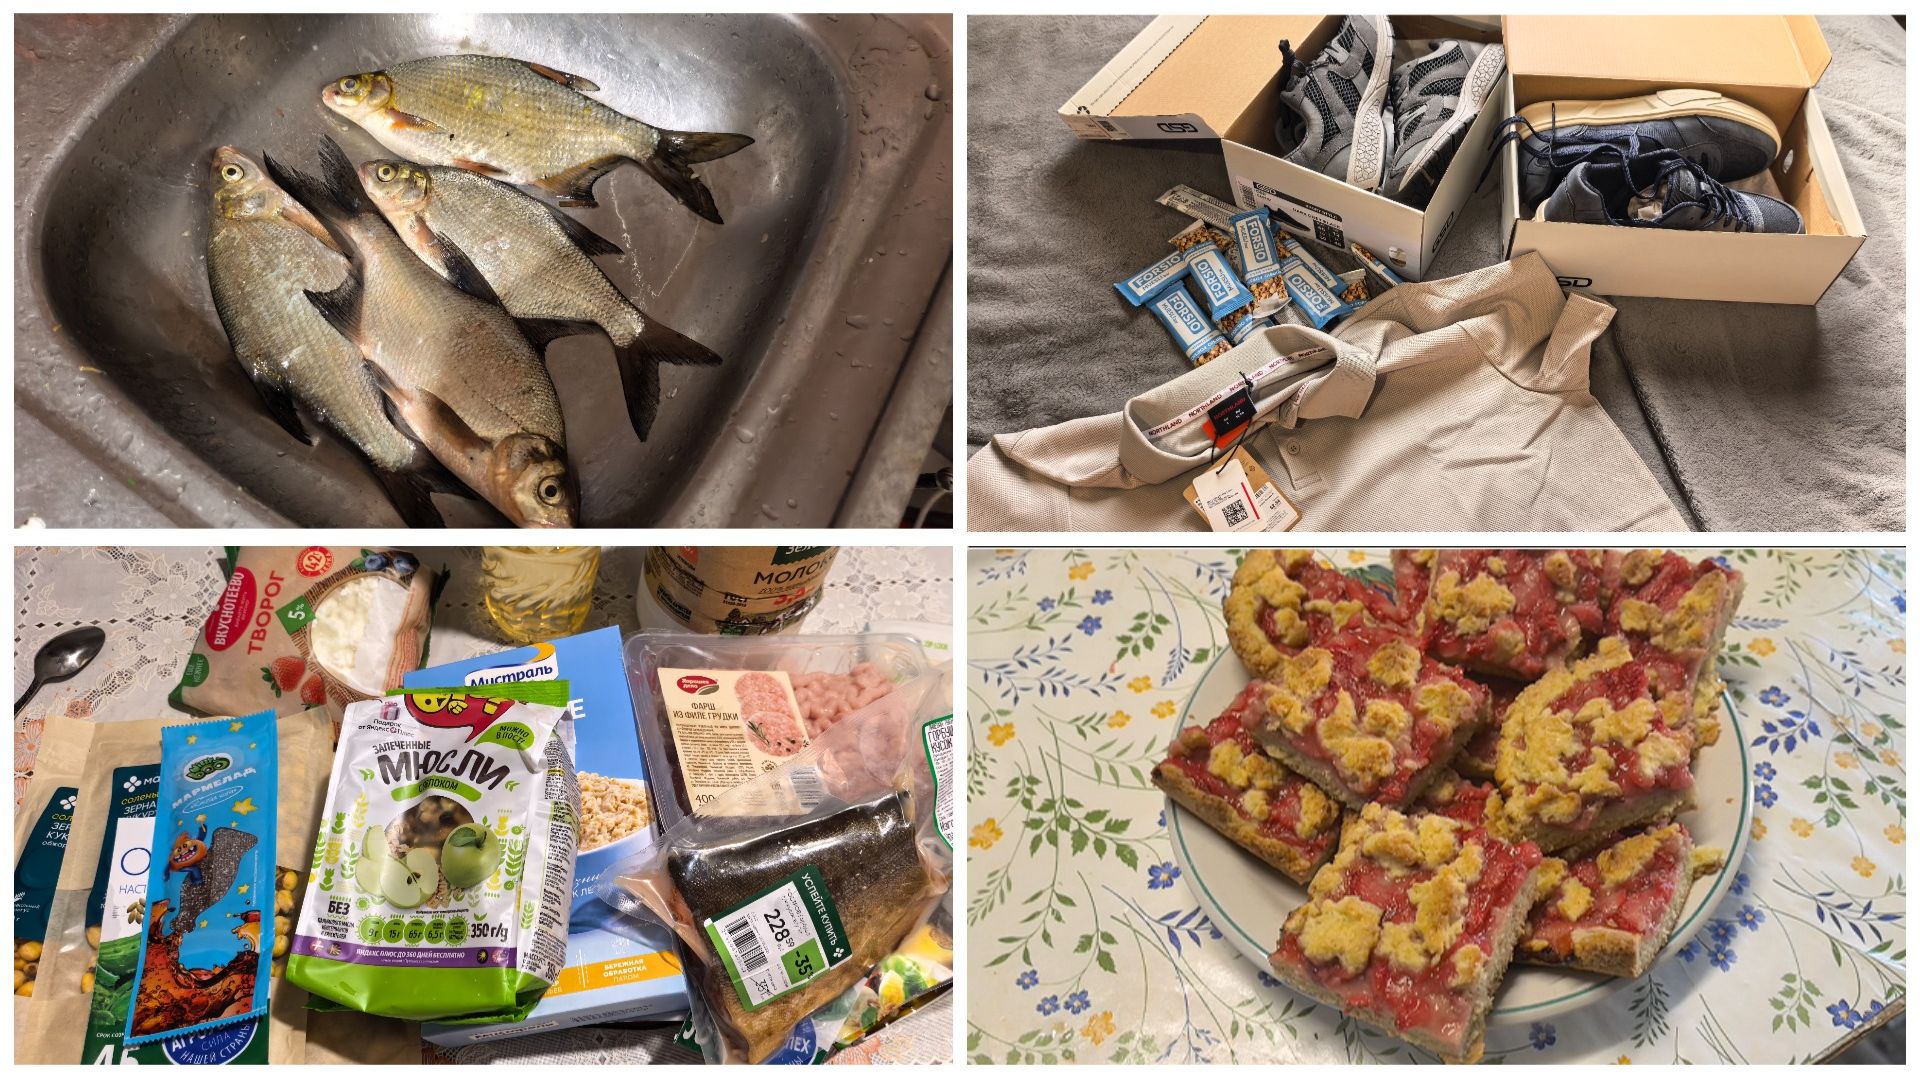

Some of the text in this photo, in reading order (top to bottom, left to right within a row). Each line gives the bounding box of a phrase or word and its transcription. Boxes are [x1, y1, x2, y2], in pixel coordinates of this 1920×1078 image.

[1247, 220, 1266, 261] FORSIO
[1135, 255, 1181, 287] FORSIO
[1197, 261, 1226, 298] FORSIO
[1291, 275, 1328, 312] FORSIO
[1169, 294, 1201, 332] FORSIO
[1188, 393, 1223, 418] NORTHLAND
[1148, 418, 1182, 437] NORTHLAND
[214, 572, 244, 646] ВКУСНОТЕЕВО
[248, 570, 285, 655] ТВОРОГ
[288, 603, 305, 620] 5%
[470, 665, 553, 686] Мистраль
[673, 710, 739, 721] ИЗ ФИЛЕ ГРУДКИ
[691, 701, 716, 711] ФАРШ
[366, 724, 390, 735] Яндекс
[500, 725, 529, 738] МОЖНО
[372, 740, 431, 754] ЗАПЕЧЕННЫЕ
[377, 749, 511, 791] МЮСЛИ
[172, 767, 257, 809] МАРМЕЛАД
[123, 801, 157, 815] ЗЕРНА
[328, 900, 350, 916] БЕЗ
[802, 873, 838, 946] УСПЕЙТЕ КУПИТЬ
[471, 923, 488, 938] 350
[764, 908, 790, 943] 228
[397, 951, 406, 959] ДО
[417, 949, 433, 959] ДНЕЙ
[432, 951, 465, 959] БЕСПЛАТНО
[603, 965, 648, 978] ОБРАБОТКА
[604, 958, 644, 970] БЕРЕЖНАЯ
[613, 973, 640, 983] ПАРОМ
[201, 1031, 231, 1052] СИЛА
[180, 1051, 217, 1065] НАШЕЙ
